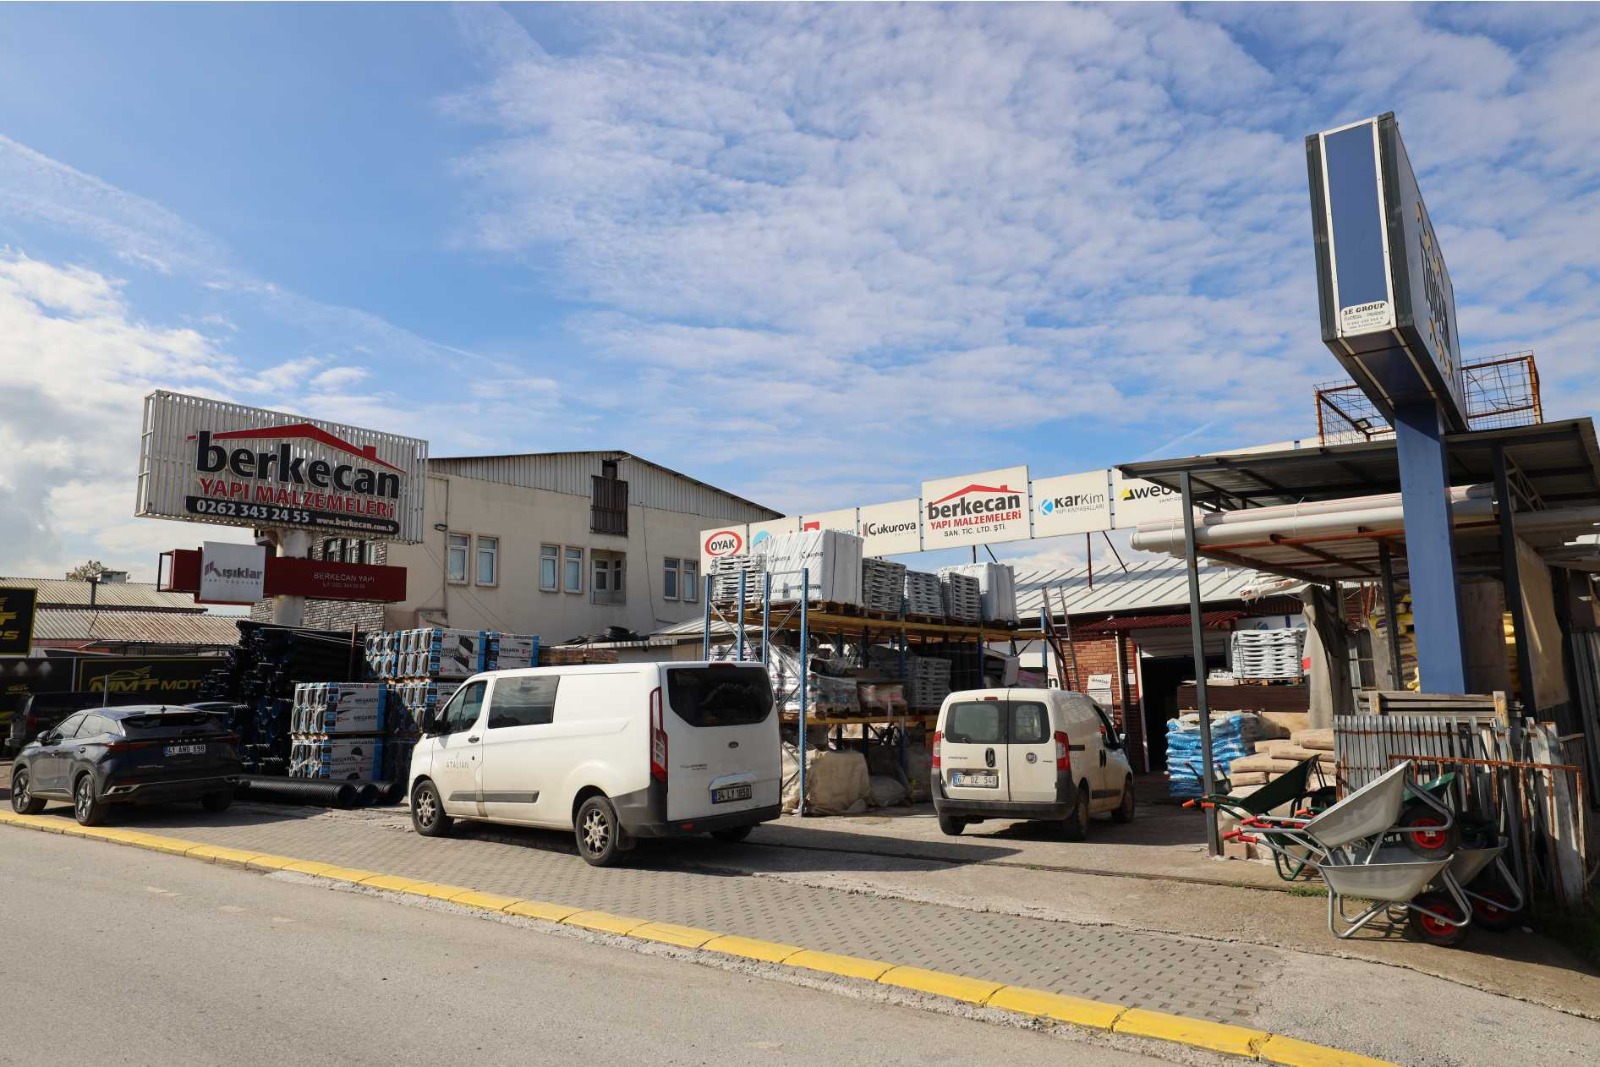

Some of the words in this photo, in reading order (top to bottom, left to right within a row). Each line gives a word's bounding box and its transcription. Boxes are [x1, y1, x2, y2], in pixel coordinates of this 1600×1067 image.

[197, 431, 399, 498] berkecan
[200, 478, 249, 500] YAPI
[196, 500, 236, 515] 0262
[240, 503, 267, 518] 343
[271, 507, 290, 521] 24
[292, 511, 310, 523] 55
[928, 495, 1020, 520] berkecan
[868, 522, 916, 536] Çukurova
[930, 520, 951, 530] YAPI
[711, 539, 735, 551] OYAK
[313, 572, 357, 581] BERKECAN
